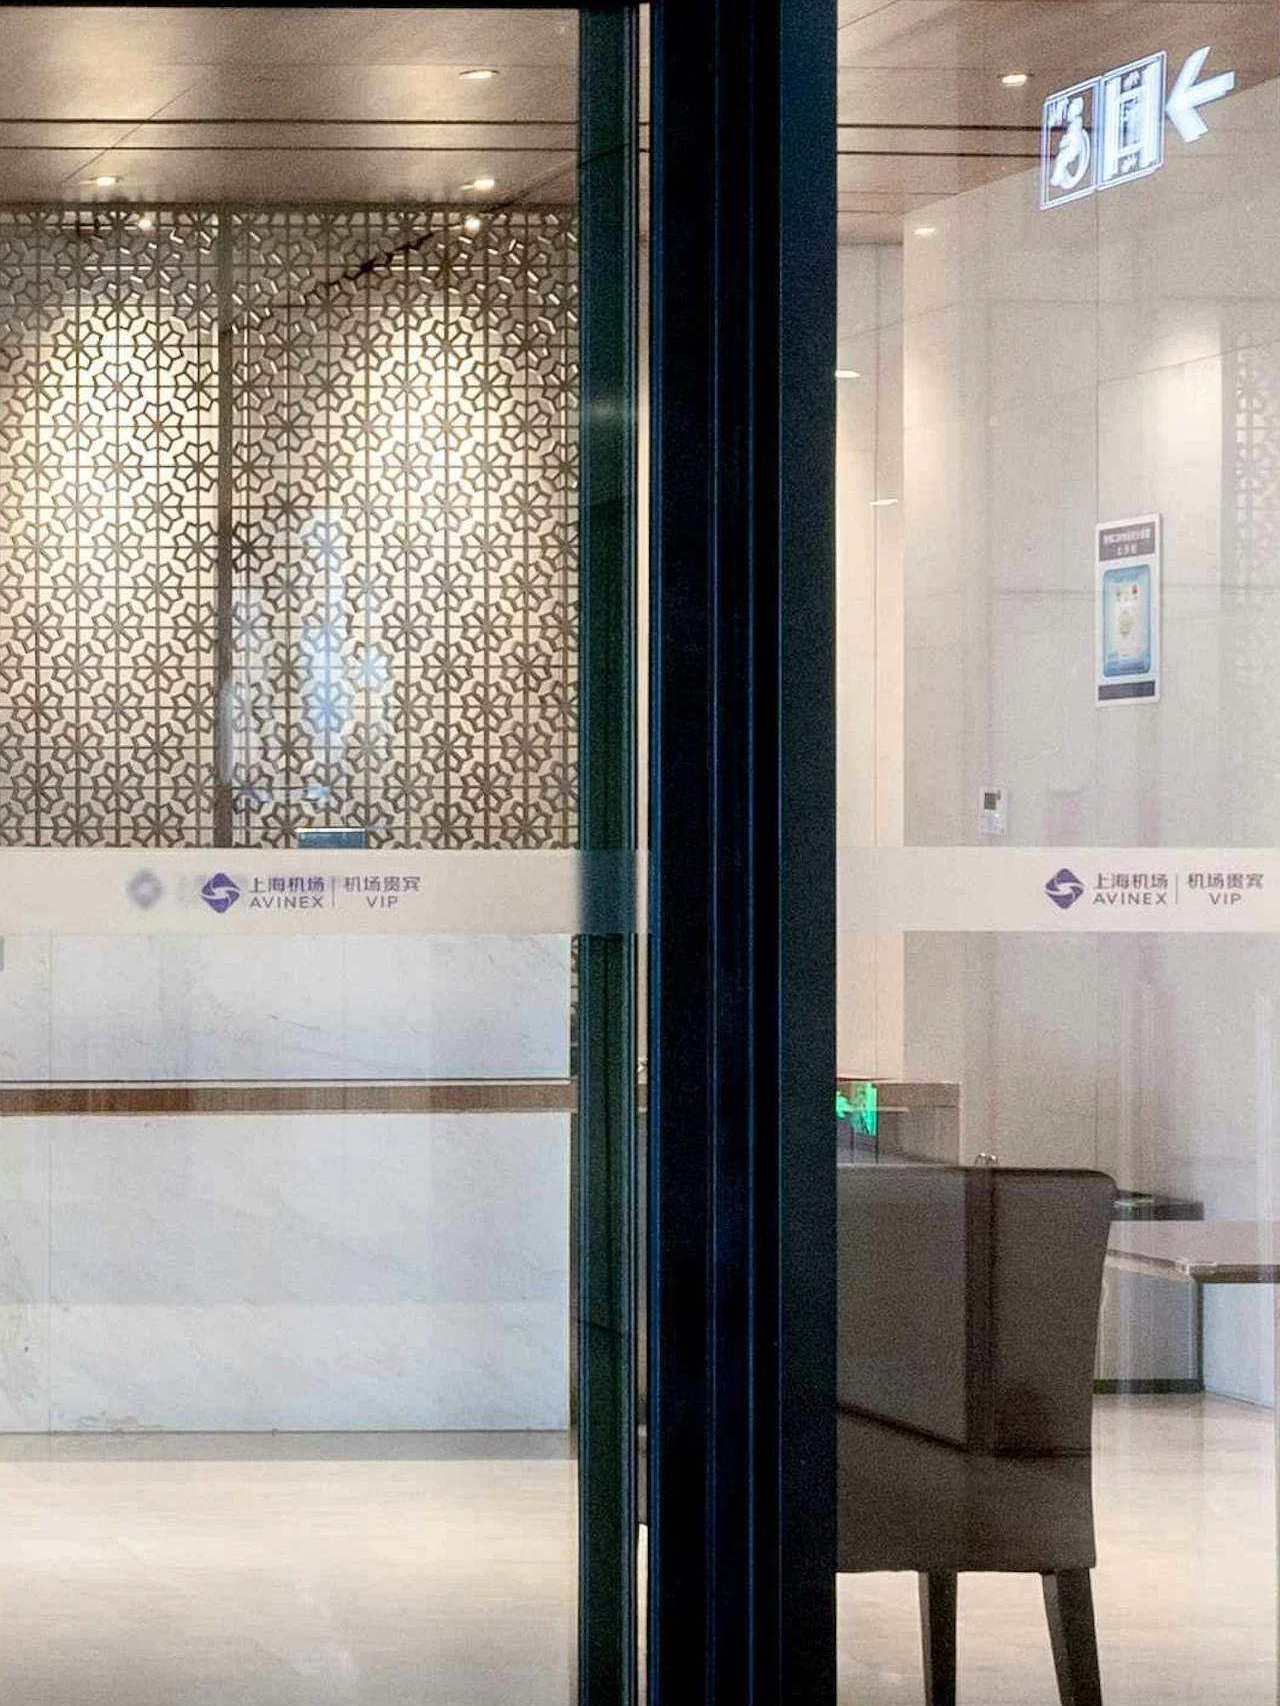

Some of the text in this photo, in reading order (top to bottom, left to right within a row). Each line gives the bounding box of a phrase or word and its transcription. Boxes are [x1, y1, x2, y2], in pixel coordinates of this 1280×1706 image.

[248, 876, 421, 893] 上海机场 机场贵宾
[1093, 873, 1264, 890] 上海机场 机场贵宾
[249, 895, 398, 909] AVINEX VIP
[1092, 892, 1242, 905] AVINEX VIP
